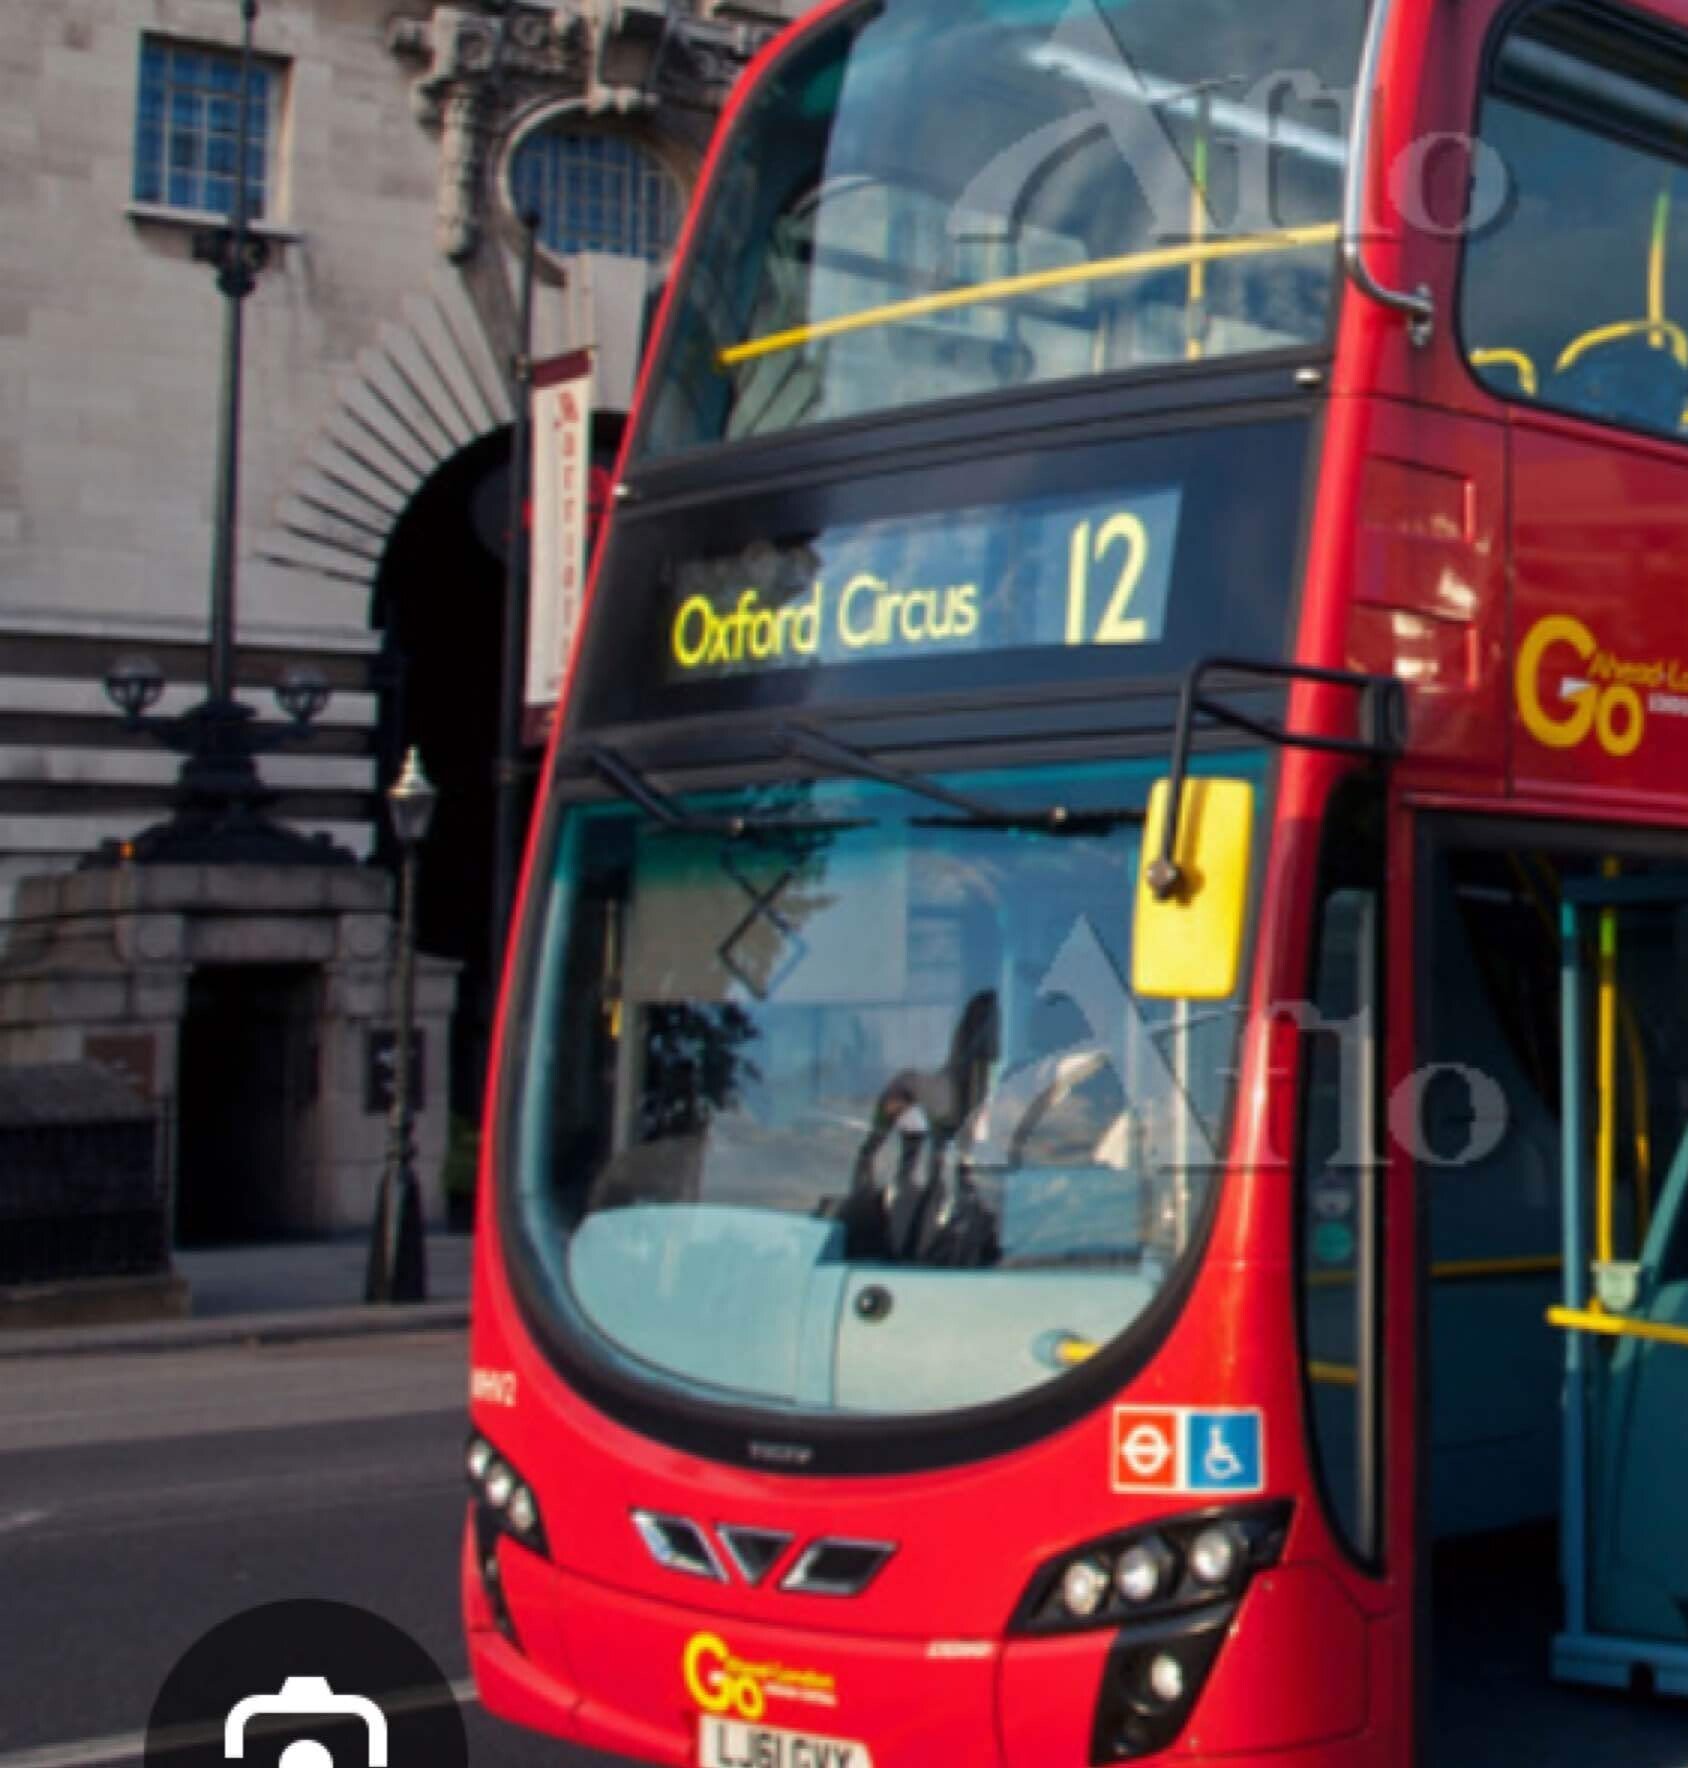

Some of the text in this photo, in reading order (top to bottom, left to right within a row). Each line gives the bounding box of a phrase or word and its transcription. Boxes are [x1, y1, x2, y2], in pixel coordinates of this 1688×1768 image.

[674, 512, 1150, 667] Oxford Circus 12
[1515, 613, 1645, 757] Go
[683, 1631, 765, 1720] Go
